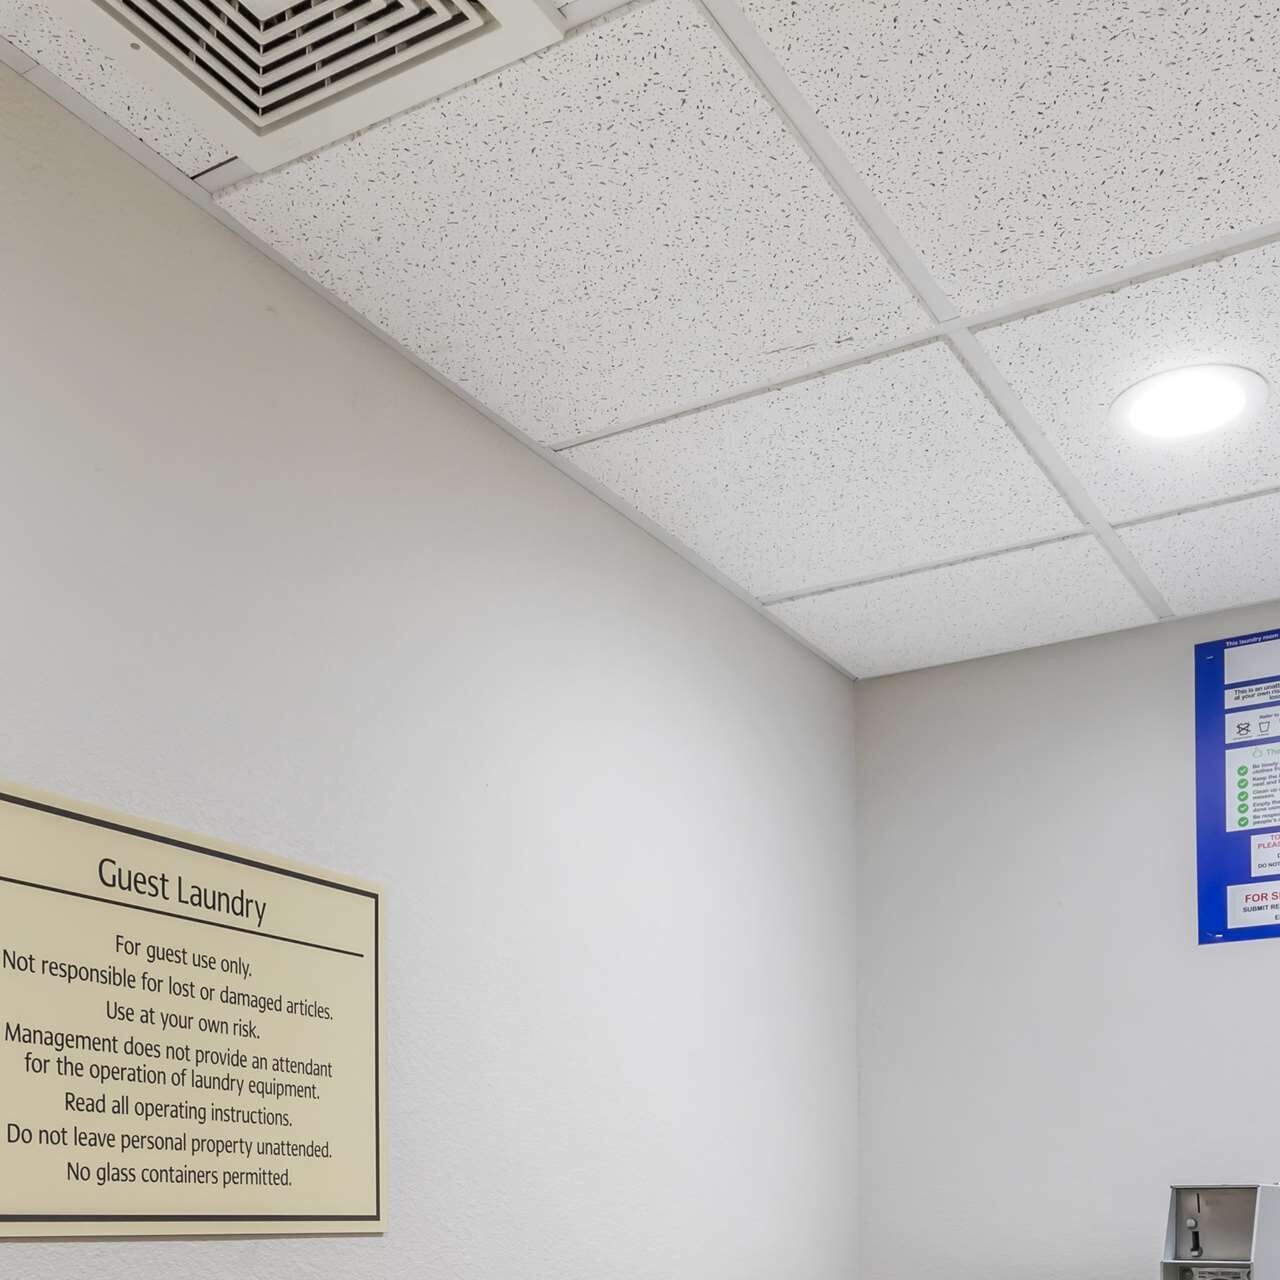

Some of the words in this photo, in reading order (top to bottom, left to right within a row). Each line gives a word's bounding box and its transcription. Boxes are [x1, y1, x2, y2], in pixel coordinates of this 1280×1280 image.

[98, 857, 170, 901] Guest
[177, 875, 267, 928] Laundry
[1243, 905, 1268, 913] SUBMIT
[1244, 892, 1268, 903] FOR
[115, 934, 142, 957] For
[146, 944, 188, 966] guest
[192, 952, 217, 971] use
[220, 956, 252, 980] only.
[2, 948, 36, 974] Not
[41, 959, 136, 989] responsible
[141, 971, 164, 993] for
[168, 975, 196, 999] lost
[199, 986, 216, 1001] or
[219, 985, 283, 1014] damaged
[286, 999, 333, 1021] articles.
[106, 1000, 135, 1023] Use
[139, 1007, 156, 1025] at
[159, 1011, 194, 1032] your
[198, 1017, 229, 1035] own
[233, 1018, 260, 1040] risk.
[4, 1021, 119, 1054] Management
[123, 1035, 161, 1059] does
[165, 1044, 191, 1062] not
[195, 1047, 248, 1069] provide
[251, 1055, 268, 1071] an
[271, 1056, 333, 1078] attendant
[24, 1051, 51, 1074] for
[55, 1055, 84, 1078] the
[89, 1063, 167, 1085] operation
[170, 1068, 188, 1087] of
[191, 1068, 245, 1097] laundry
[248, 1077, 320, 1100] equipment.
[65, 1091, 106, 1114] Read
[111, 1095, 129, 1115] all
[134, 1100, 207, 1125] operating
[211, 1102, 293, 1127] instructions.
[7, 1123, 33, 1144] Do
[38, 1127, 68, 1146] not
[73, 1125, 116, 1148] leave
[120, 1132, 187, 1153] personal
[191, 1137, 253, 1159] property
[256, 1140, 332, 1159] unattended.
[67, 1161, 91, 1182] No
[96, 1161, 137, 1186] glass
[141, 1164, 219, 1185] containers
[222, 1167, 292, 1189] permitted.
